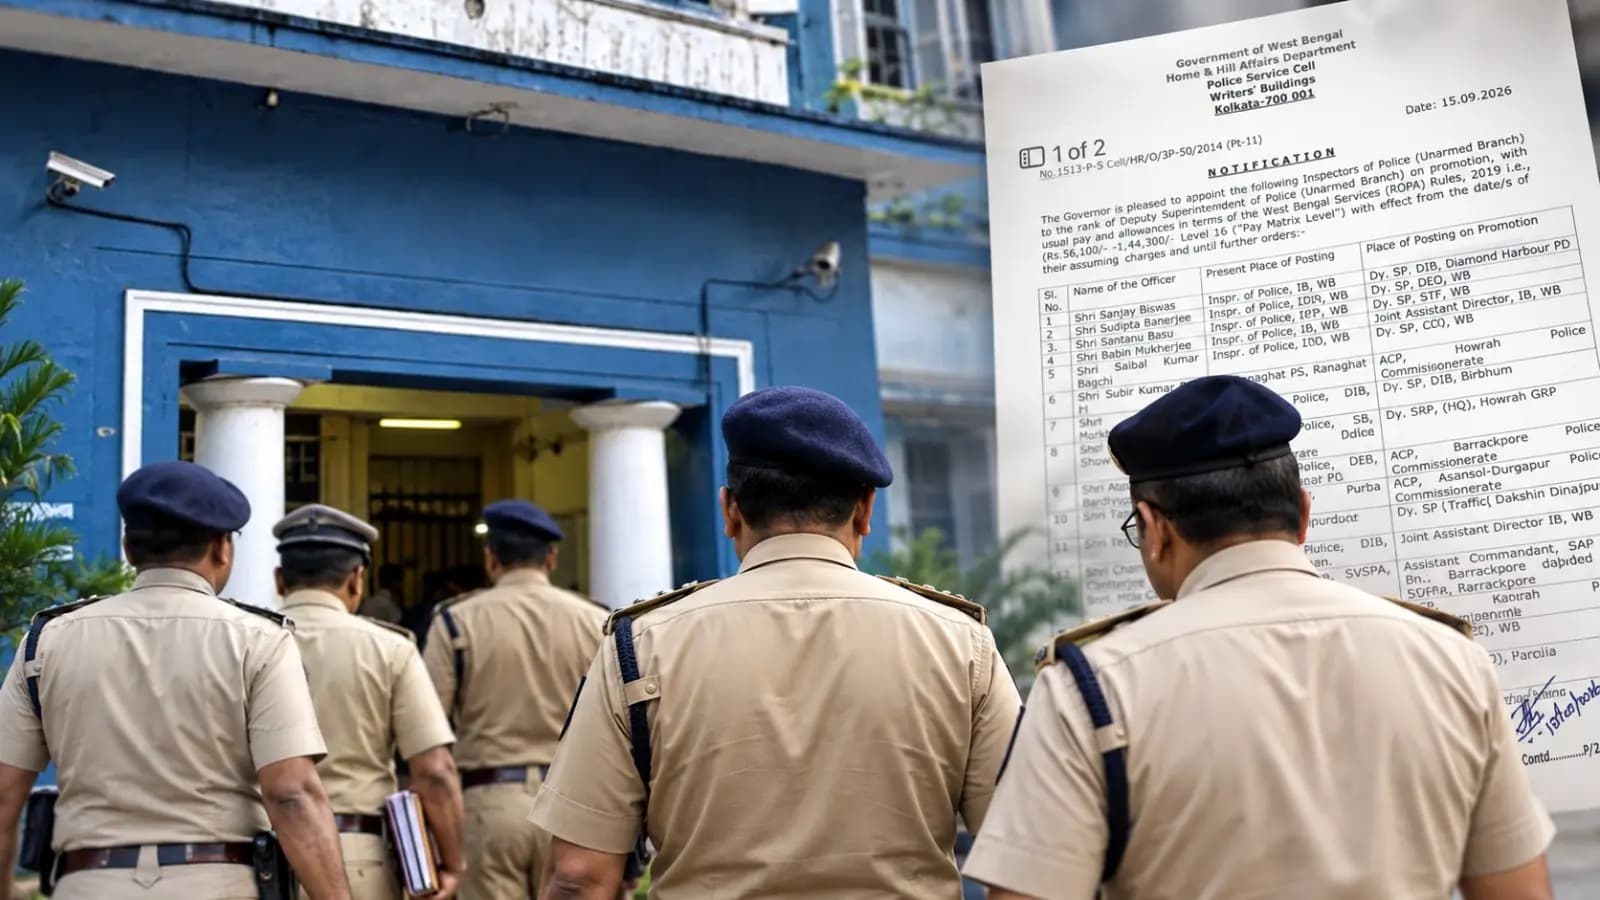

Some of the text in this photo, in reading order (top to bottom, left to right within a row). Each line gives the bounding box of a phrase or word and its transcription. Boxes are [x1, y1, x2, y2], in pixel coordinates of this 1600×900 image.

[1165, 39, 1357, 83] Home & Hill Affairs Department
[1175, 28, 1344, 69] Government of West Bengal
[1206, 60, 1316, 90] Police Service Cell
[1259, 75, 1316, 94] Buildings
[1290, 87, 1316, 102] 001
[1405, 84, 1513, 115] Date: 15.09.2026
[1052, 138, 1107, 163] 1 of 2
[1226, 134, 1263, 151] (Pt-11)
[1040, 132, 1525, 225] The Governor is pleased to appoint the following Inspectors of Police (Unarmed Branch)
[1040, 146, 1528, 238] to the rank of Deputy of Police (Unarmed Branch) on promotion, with
[1041, 236, 1069, 249] usual
[1072, 235, 1092, 247] pay
[1094, 230, 1115, 242] and
[1117, 223, 1175, 239] allowances
[1178, 220, 1189, 230] in
[1191, 215, 1224, 228] terms
[1226, 211, 1237, 223] of
[1240, 209, 1259, 220] the
[1262, 203, 1289, 217] West
[1292, 195, 1330, 212] Bengal
[1333, 188, 1381, 205] Services
[1384, 178, 1426, 197] (ROPA)
[1429, 173, 1466, 187] Rules,
[1470, 164, 1502, 180] 2019
[1180, 228, 1209, 242] Level
[1214, 226, 1228, 237] 16
[1266, 215, 1301, 230] Matrix
[1350, 202, 1375, 215] with
[1379, 195, 1413, 210] effect
[1415, 190, 1445, 204] from
[1448, 186, 1469, 198] the
[1472, 177, 1513, 193] date/s
[1516, 172, 1529, 185] of
[1365, 216, 1539, 254] Place of Posting on Promotion
[1042, 262, 1067, 274] their
[1069, 256, 1120, 271] assuming
[1124, 250, 1166, 263] charges
[1169, 244, 1190, 257] and
[1192, 240, 1217, 254] until
[1219, 236, 1258, 249] further
[1205, 251, 1335, 278] Present Place of Posting
[1369, 238, 1571, 282] Dy. DIB, Diamond Harbour PD
[1043, 289, 1057, 300] Sl.
[1073, 275, 1176, 296] Name of the Officer
[1208, 277, 1337, 305] Inspr. of Police, IB, WB
[1044, 302, 1062, 315] No.
[1074, 302, 1176, 325] Shri Sanjay Biswas
[1374, 284, 1562, 324] Joint Assistant Director, IB, WB
[1074, 314, 1192, 339] Shri Sudipta Banerjee
[1075, 330, 1174, 350] Shri Santanu Basu
[1076, 341, 1192, 364] Shri Babin Mukherjee
[1379, 326, 1586, 366] ACP, Howrah Police
[1312, 358, 1367, 374] Ranaghat
[1460, 365, 1513, 382] Birbhum
[1385, 409, 1406, 421] Dy.
[1409, 404, 1438, 417] SRP,
[1479, 391, 1527, 407] Howrah
[1530, 386, 1557, 400] GRP
[1390, 422, 1600, 461] ACP, Barrackpore Police
[1348, 453, 1378, 467] DEB,
[1391, 452, 1498, 475] Commissionerate
[1438, 459, 1551, 483] Asansol-Durgapur
[1346, 482, 1381, 495] Purba
[1494, 489, 1546, 505] Dakshin
[1403, 555, 1460, 572] Assistant
[1567, 538, 1594, 552] SAP
